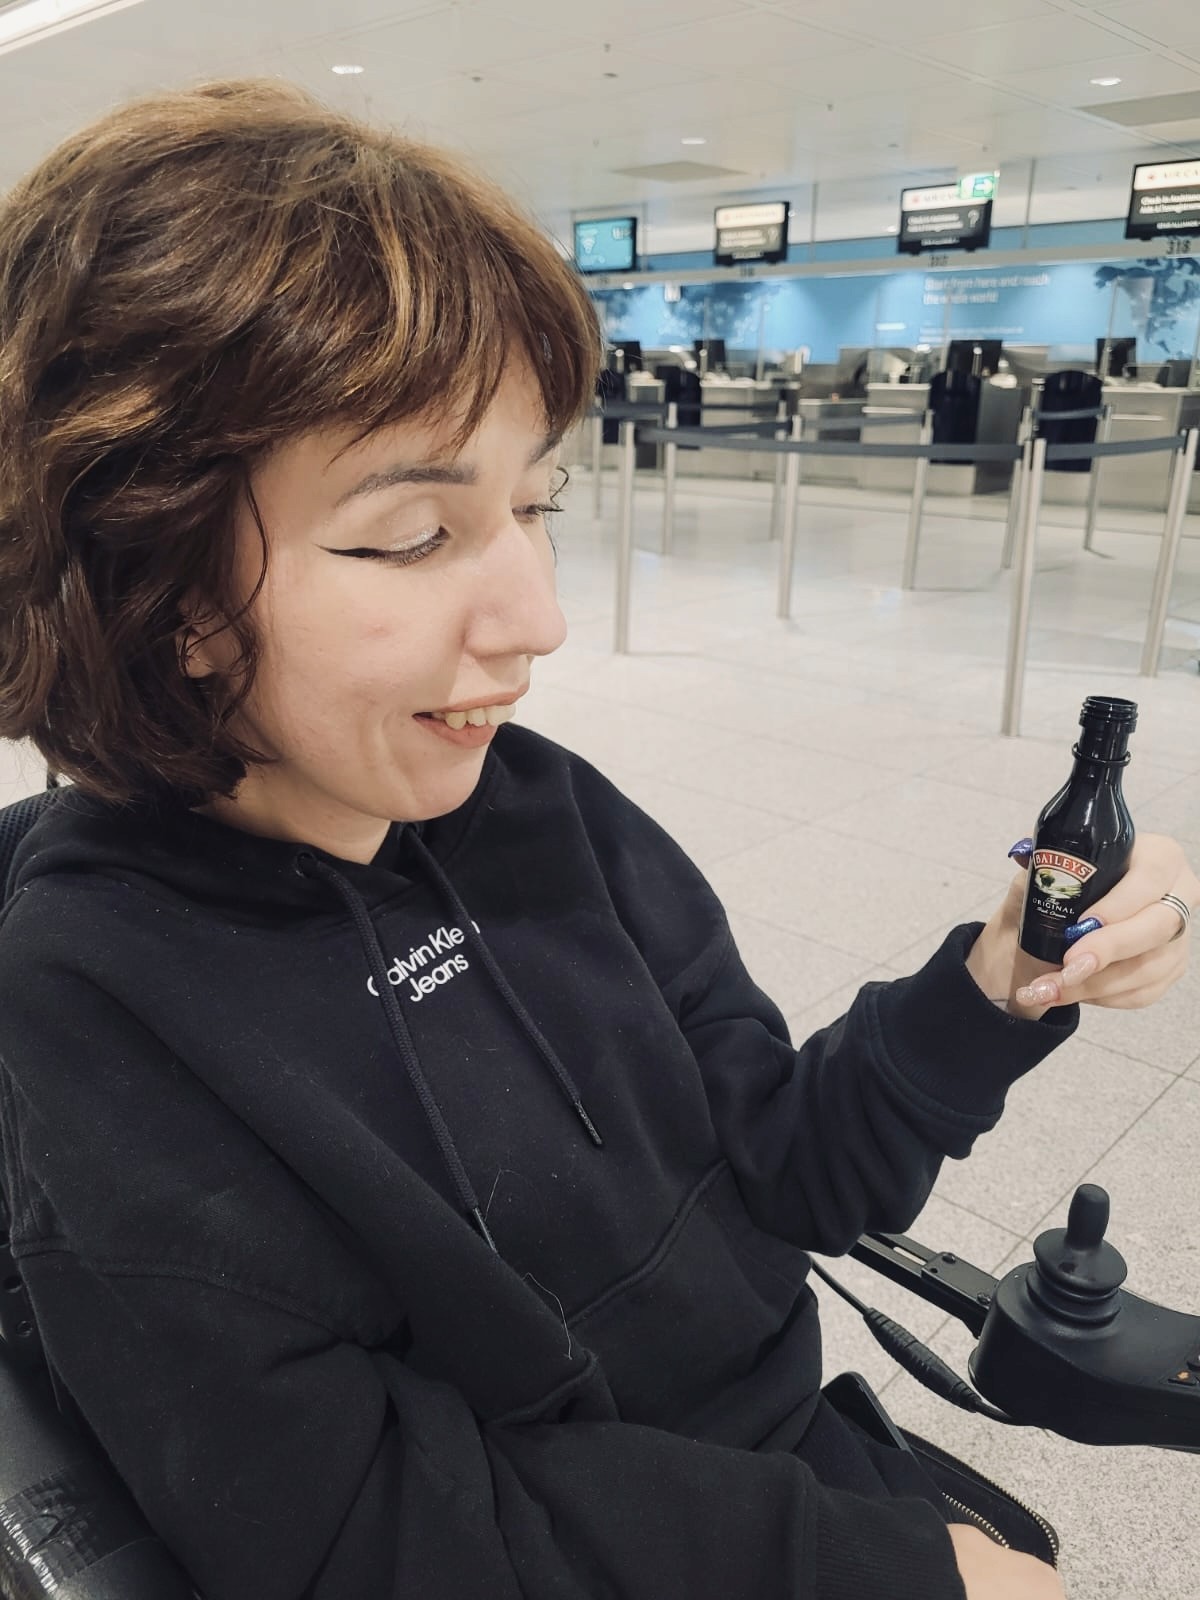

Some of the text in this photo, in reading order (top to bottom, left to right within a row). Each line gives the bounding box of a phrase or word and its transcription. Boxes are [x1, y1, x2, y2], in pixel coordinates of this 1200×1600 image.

[1036, 854, 1088, 875] BAILEYS
[1032, 897, 1073, 914] ORIGINAL
[428, 920, 480, 955] Kle
[410, 954, 469, 1002] Jeans
